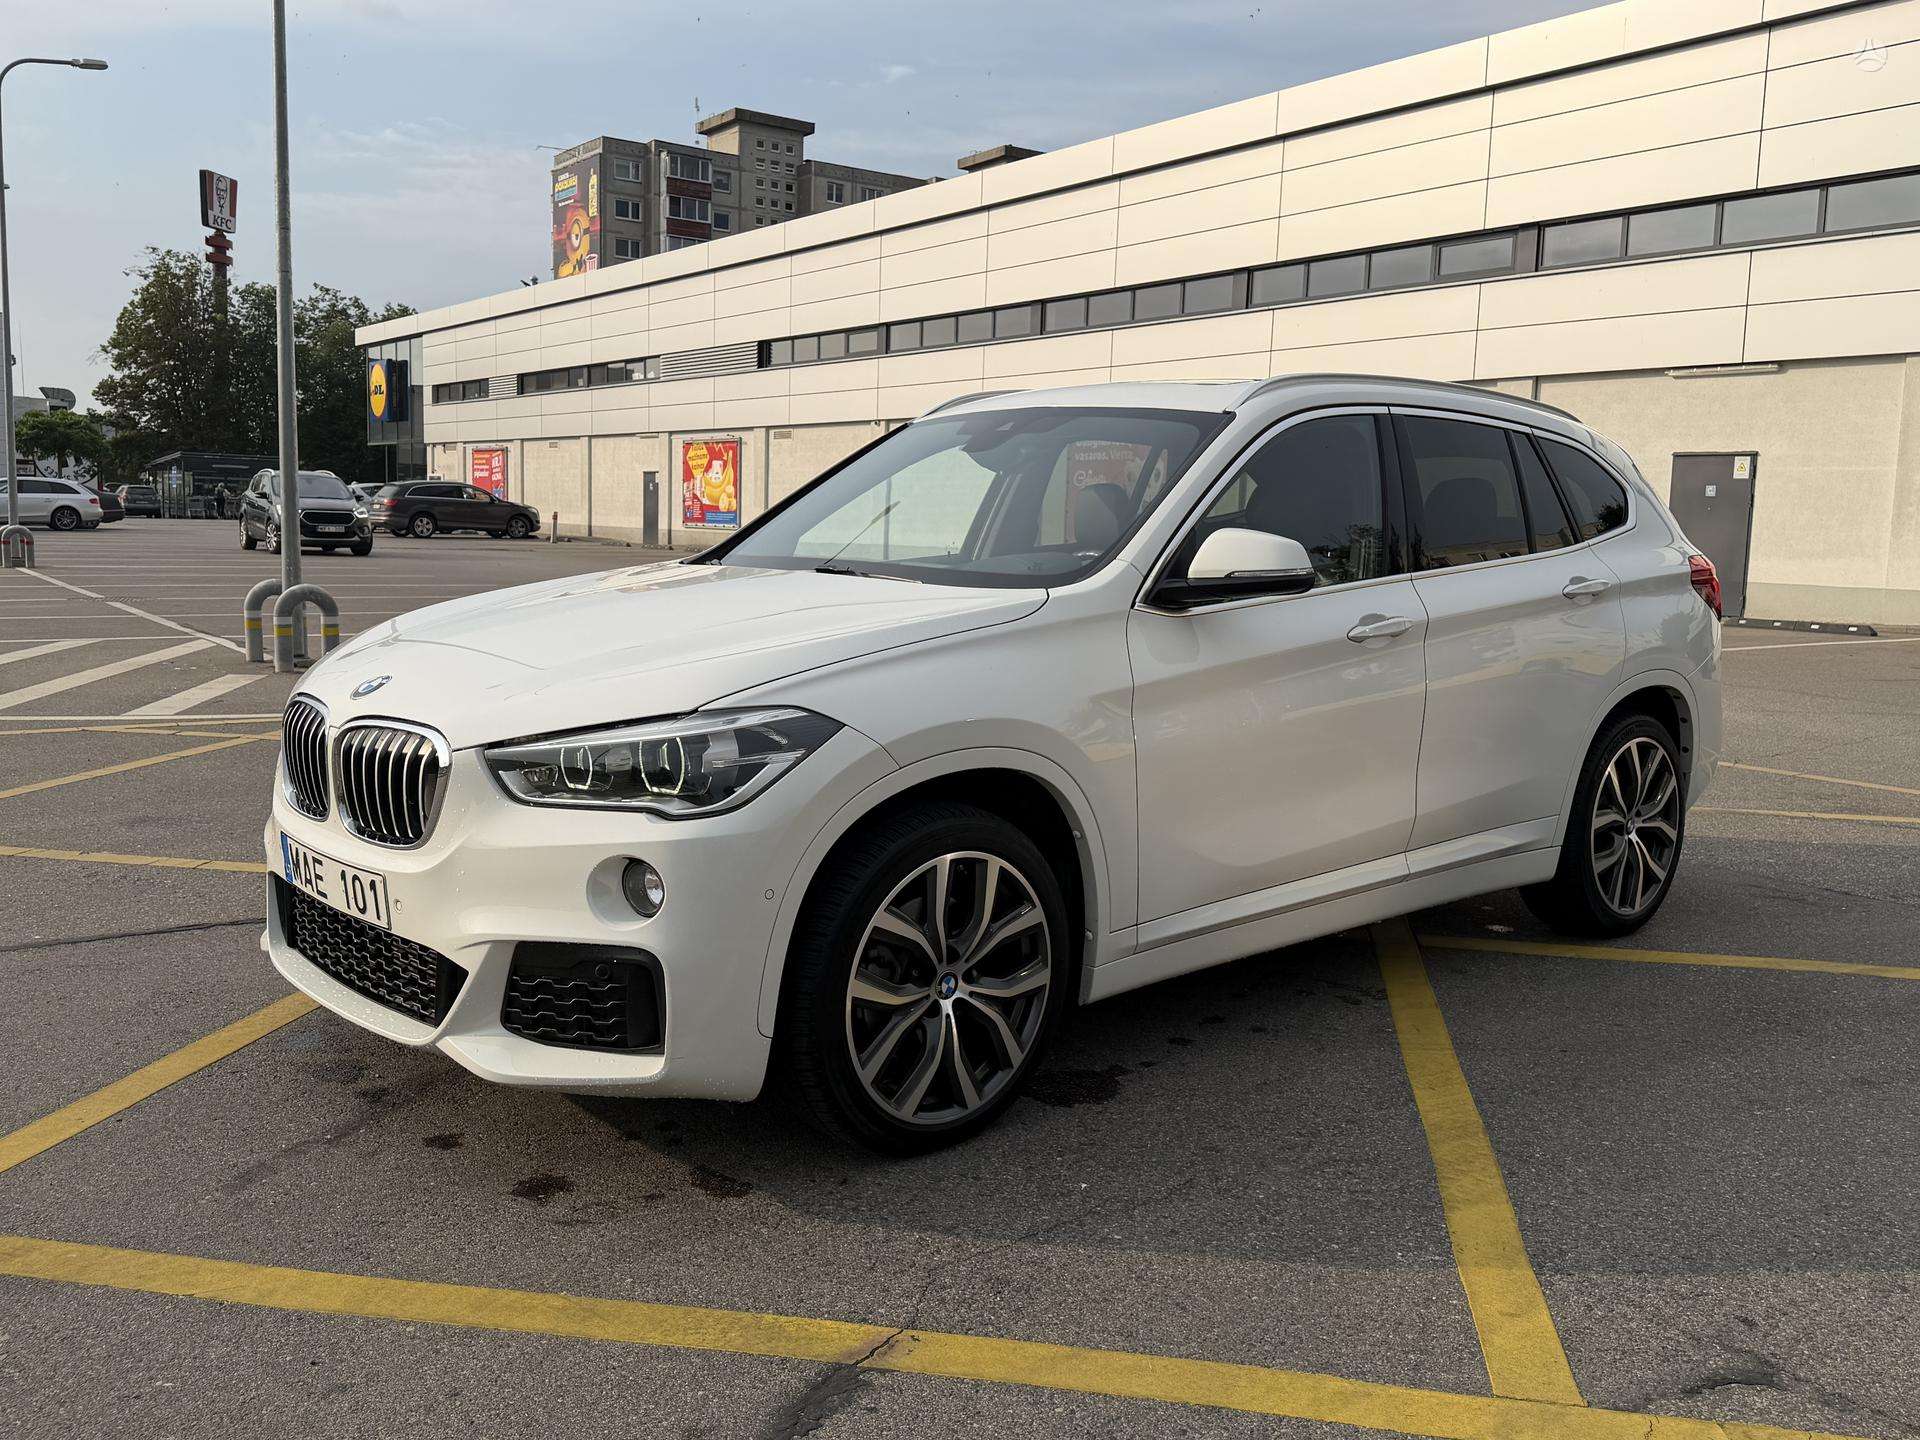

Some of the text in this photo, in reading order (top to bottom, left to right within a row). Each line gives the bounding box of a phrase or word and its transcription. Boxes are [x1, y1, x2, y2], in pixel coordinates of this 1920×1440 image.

[213, 214, 232, 230] KFC
[289, 843, 381, 921] MAE 101
